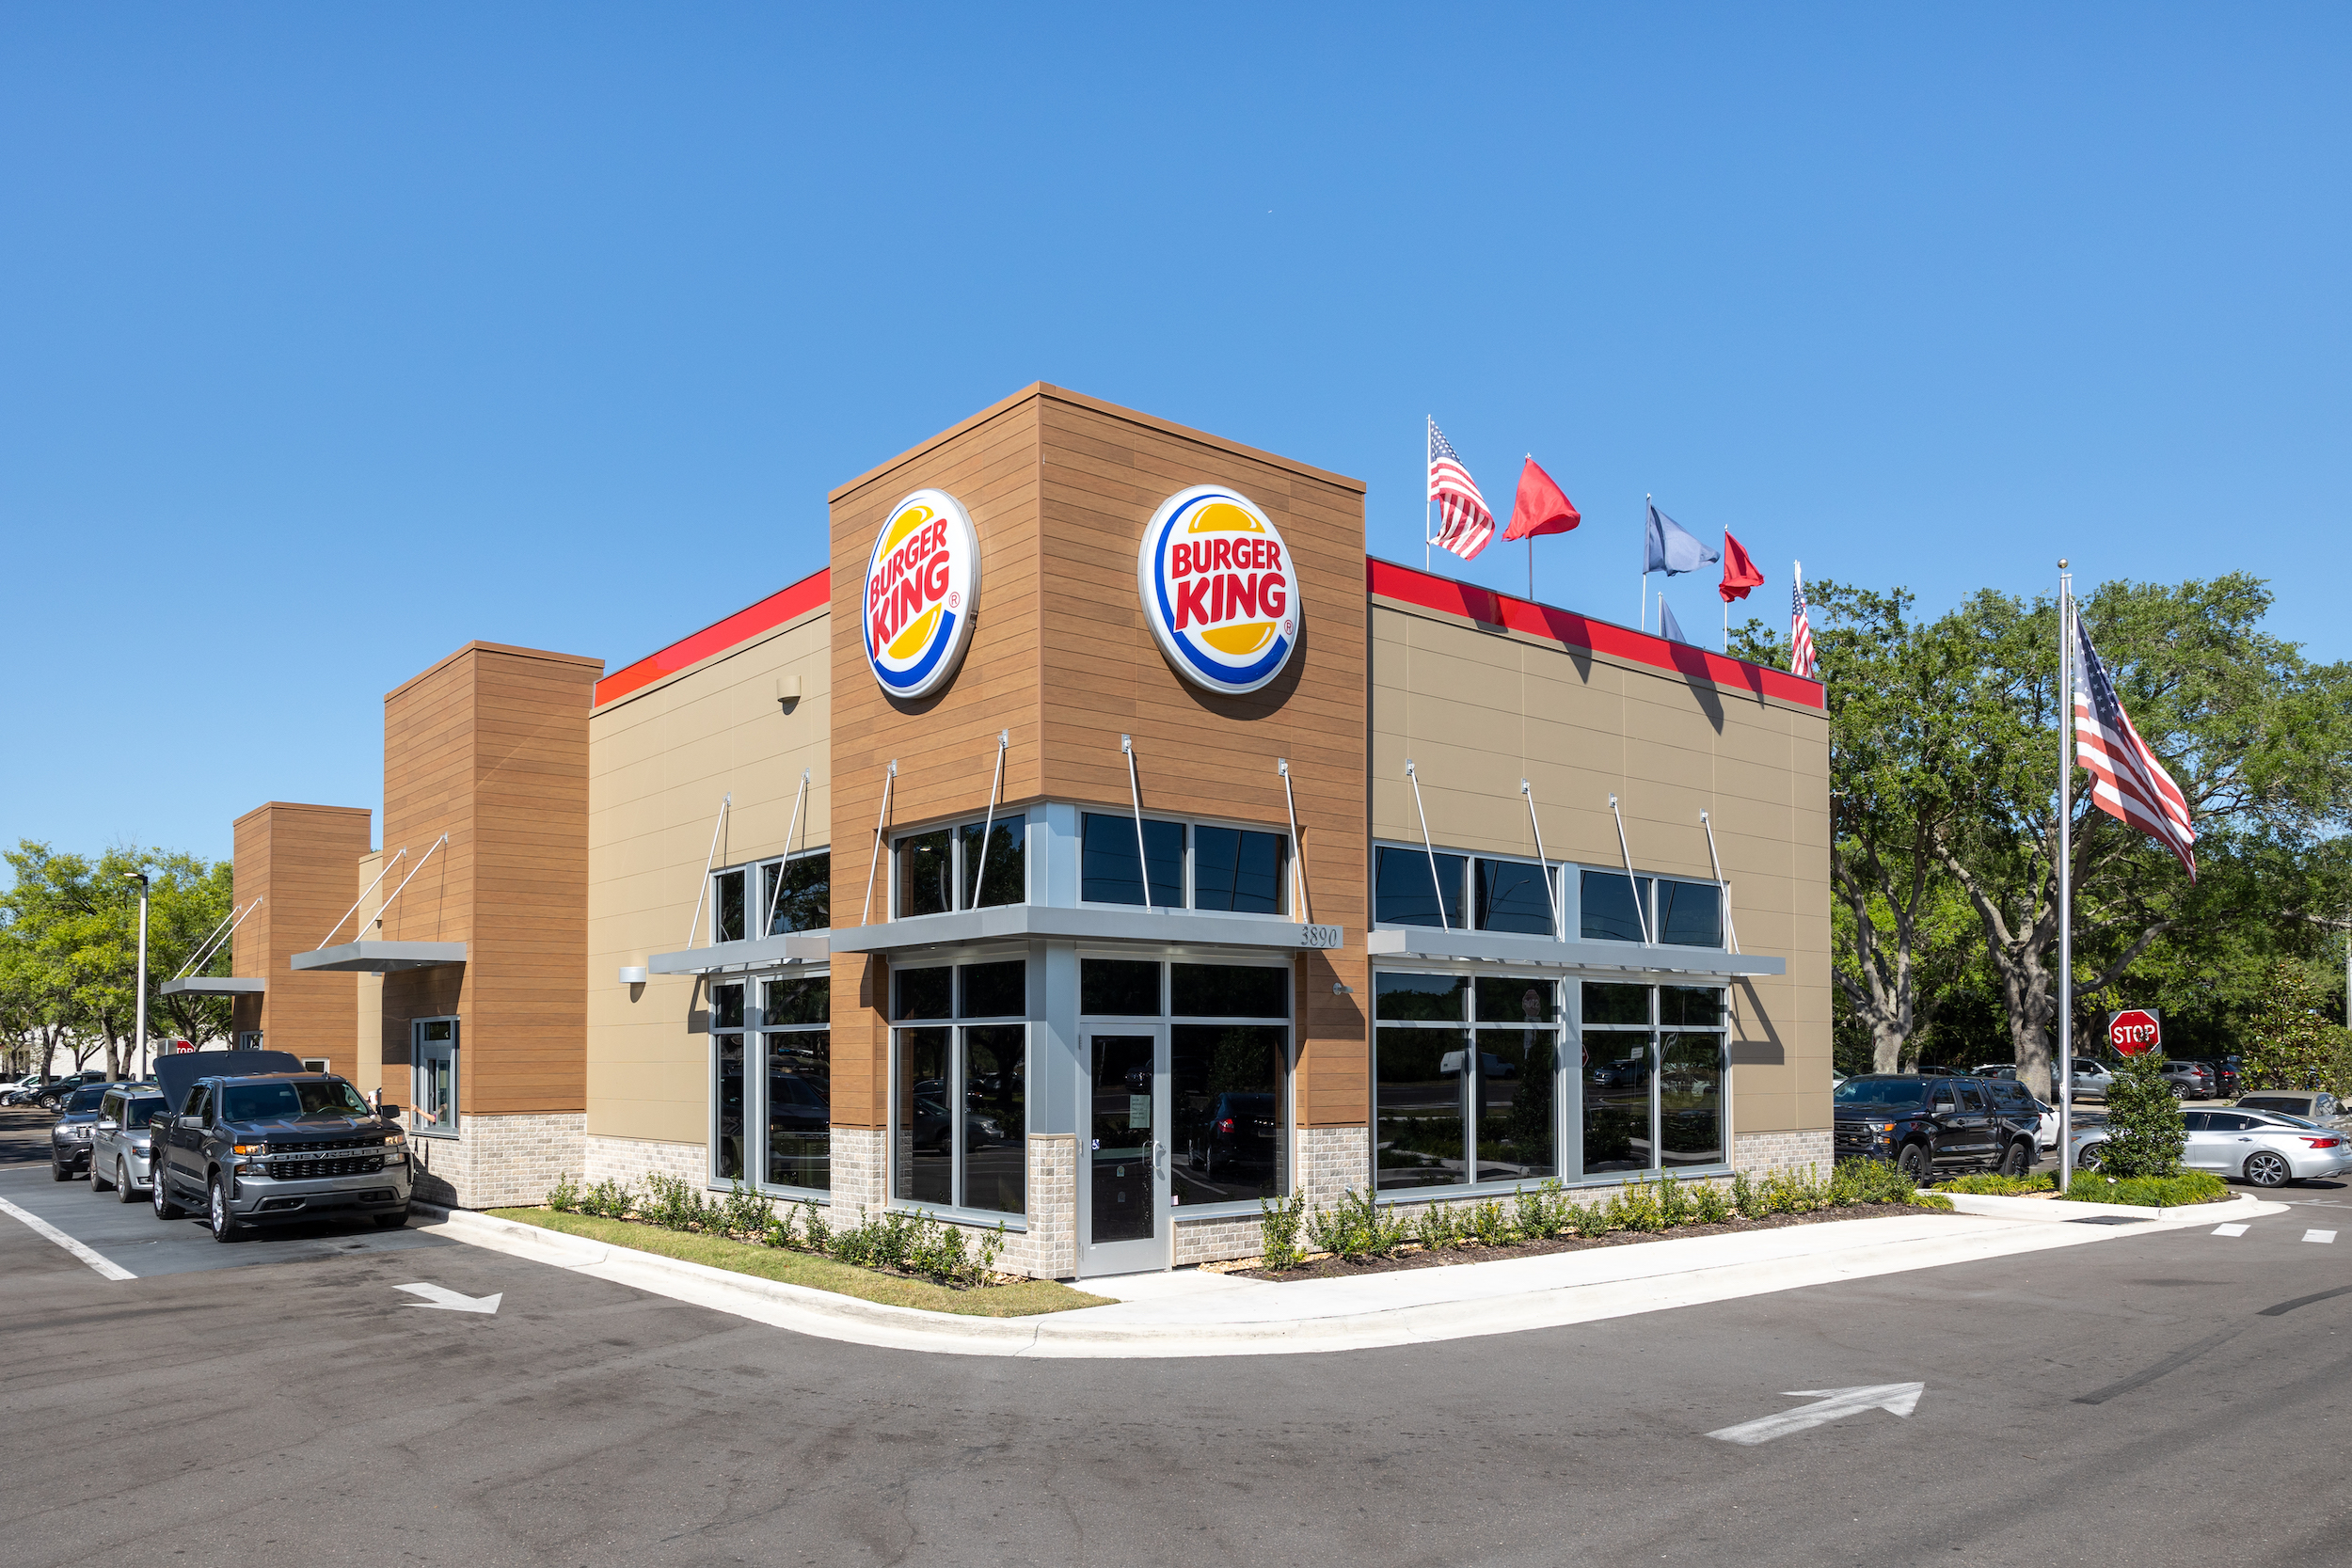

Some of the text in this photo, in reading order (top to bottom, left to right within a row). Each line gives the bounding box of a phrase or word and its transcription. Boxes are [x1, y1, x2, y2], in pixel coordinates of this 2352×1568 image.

[870, 518, 947, 614] BURGER
[1172, 537, 1282, 579] BURGER
[873, 550, 949, 659] KING
[1175, 572, 1286, 631] KING
[1300, 926, 1337, 947] 3890
[2113, 1024, 2155, 1044] STOP
[274, 1148, 383, 1162] CHEVROLET
